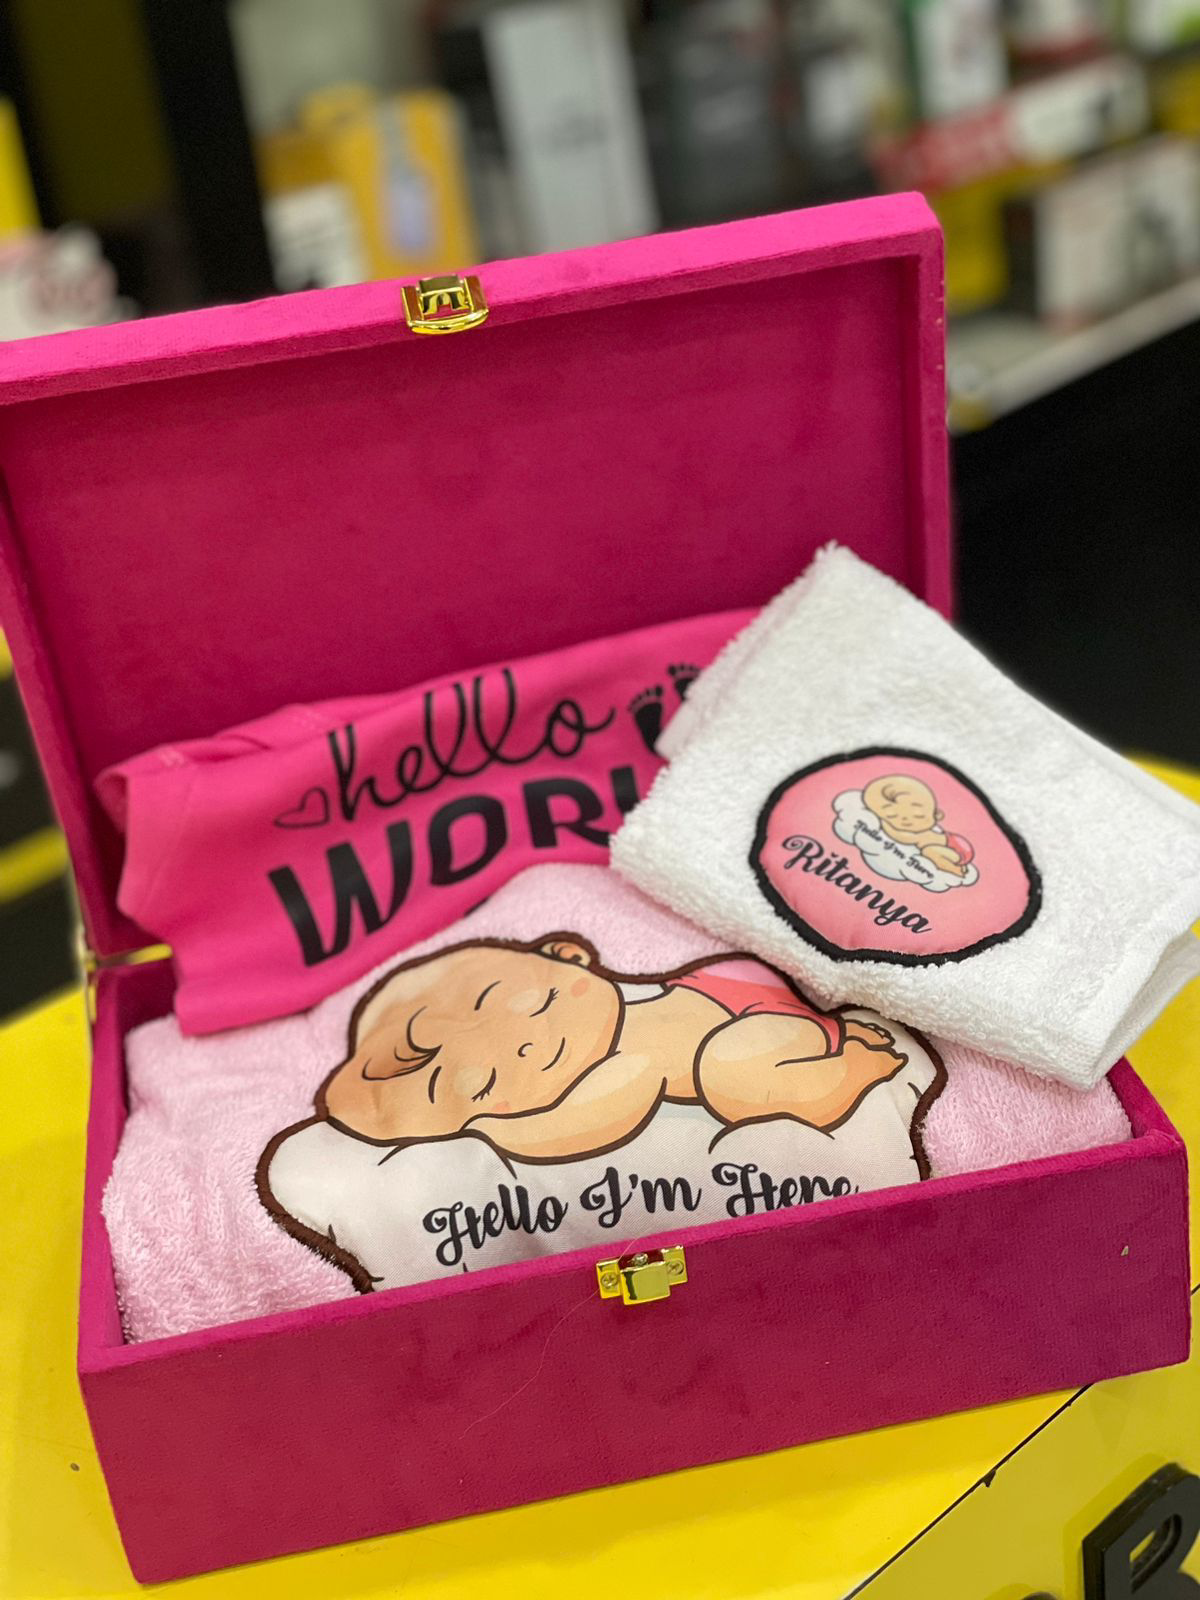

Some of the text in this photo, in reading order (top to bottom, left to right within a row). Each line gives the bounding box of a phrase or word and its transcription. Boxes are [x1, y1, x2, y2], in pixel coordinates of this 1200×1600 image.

[327, 667, 617, 822] hello
[781, 834, 933, 935] Ritanya
[422, 1183, 569, 1267] Hello
[580, 1166, 702, 1229] I'm
